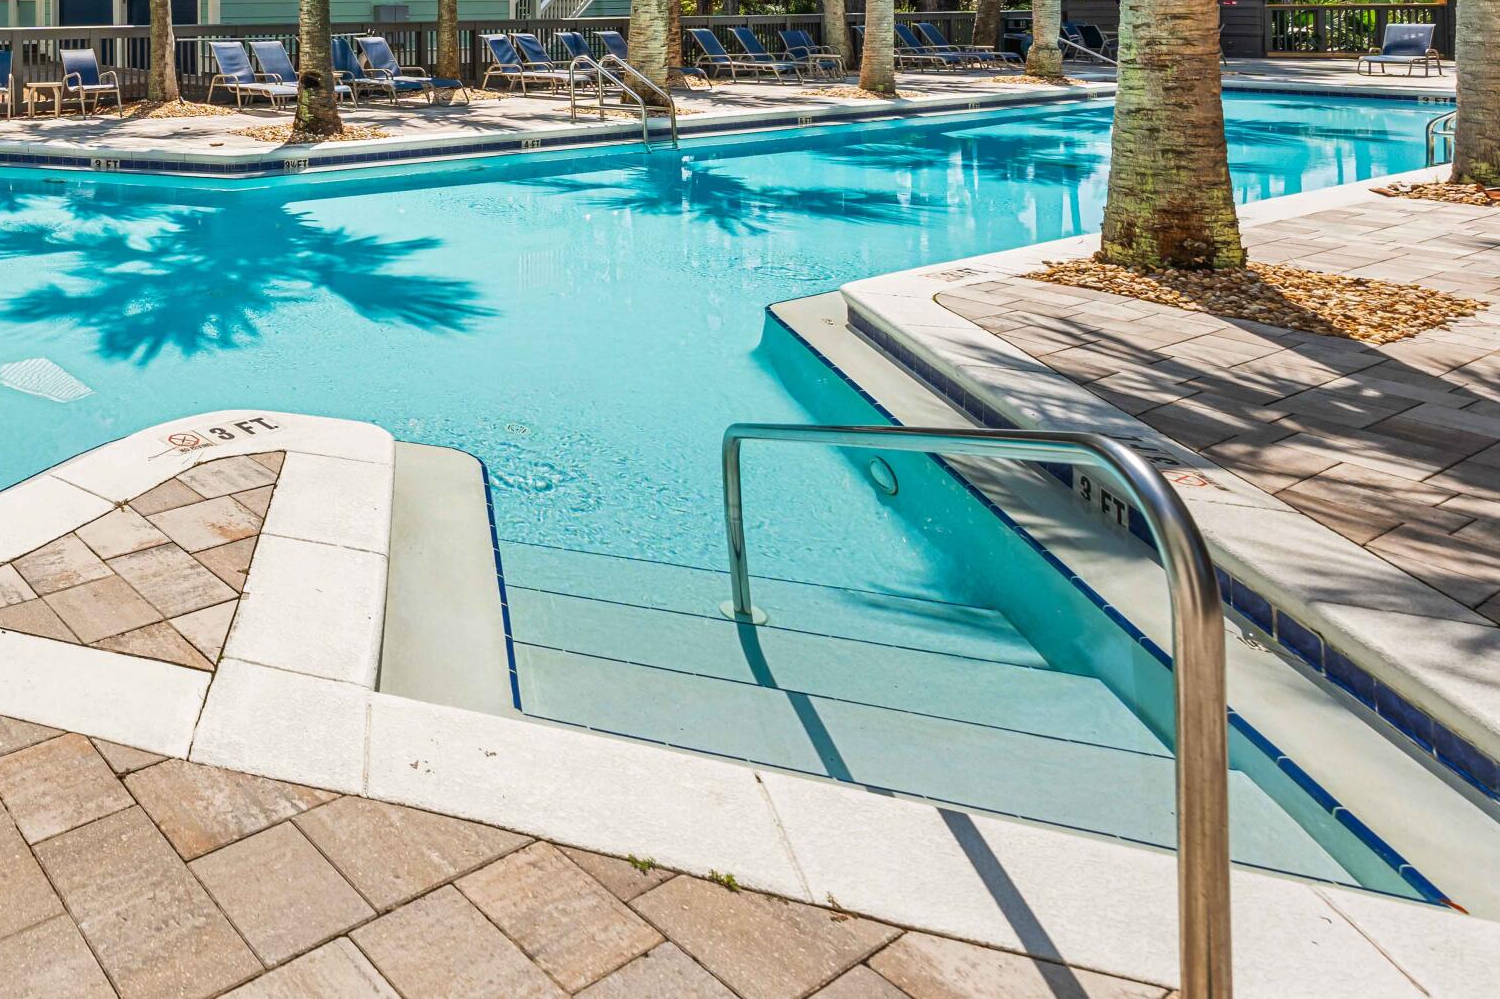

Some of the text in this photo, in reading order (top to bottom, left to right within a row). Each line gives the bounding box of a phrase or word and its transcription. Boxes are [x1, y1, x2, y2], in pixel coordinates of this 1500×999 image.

[524, 140, 529, 148] 4
[208, 417, 279, 440] 3 FT.
[1080, 475, 1092, 502] 3
